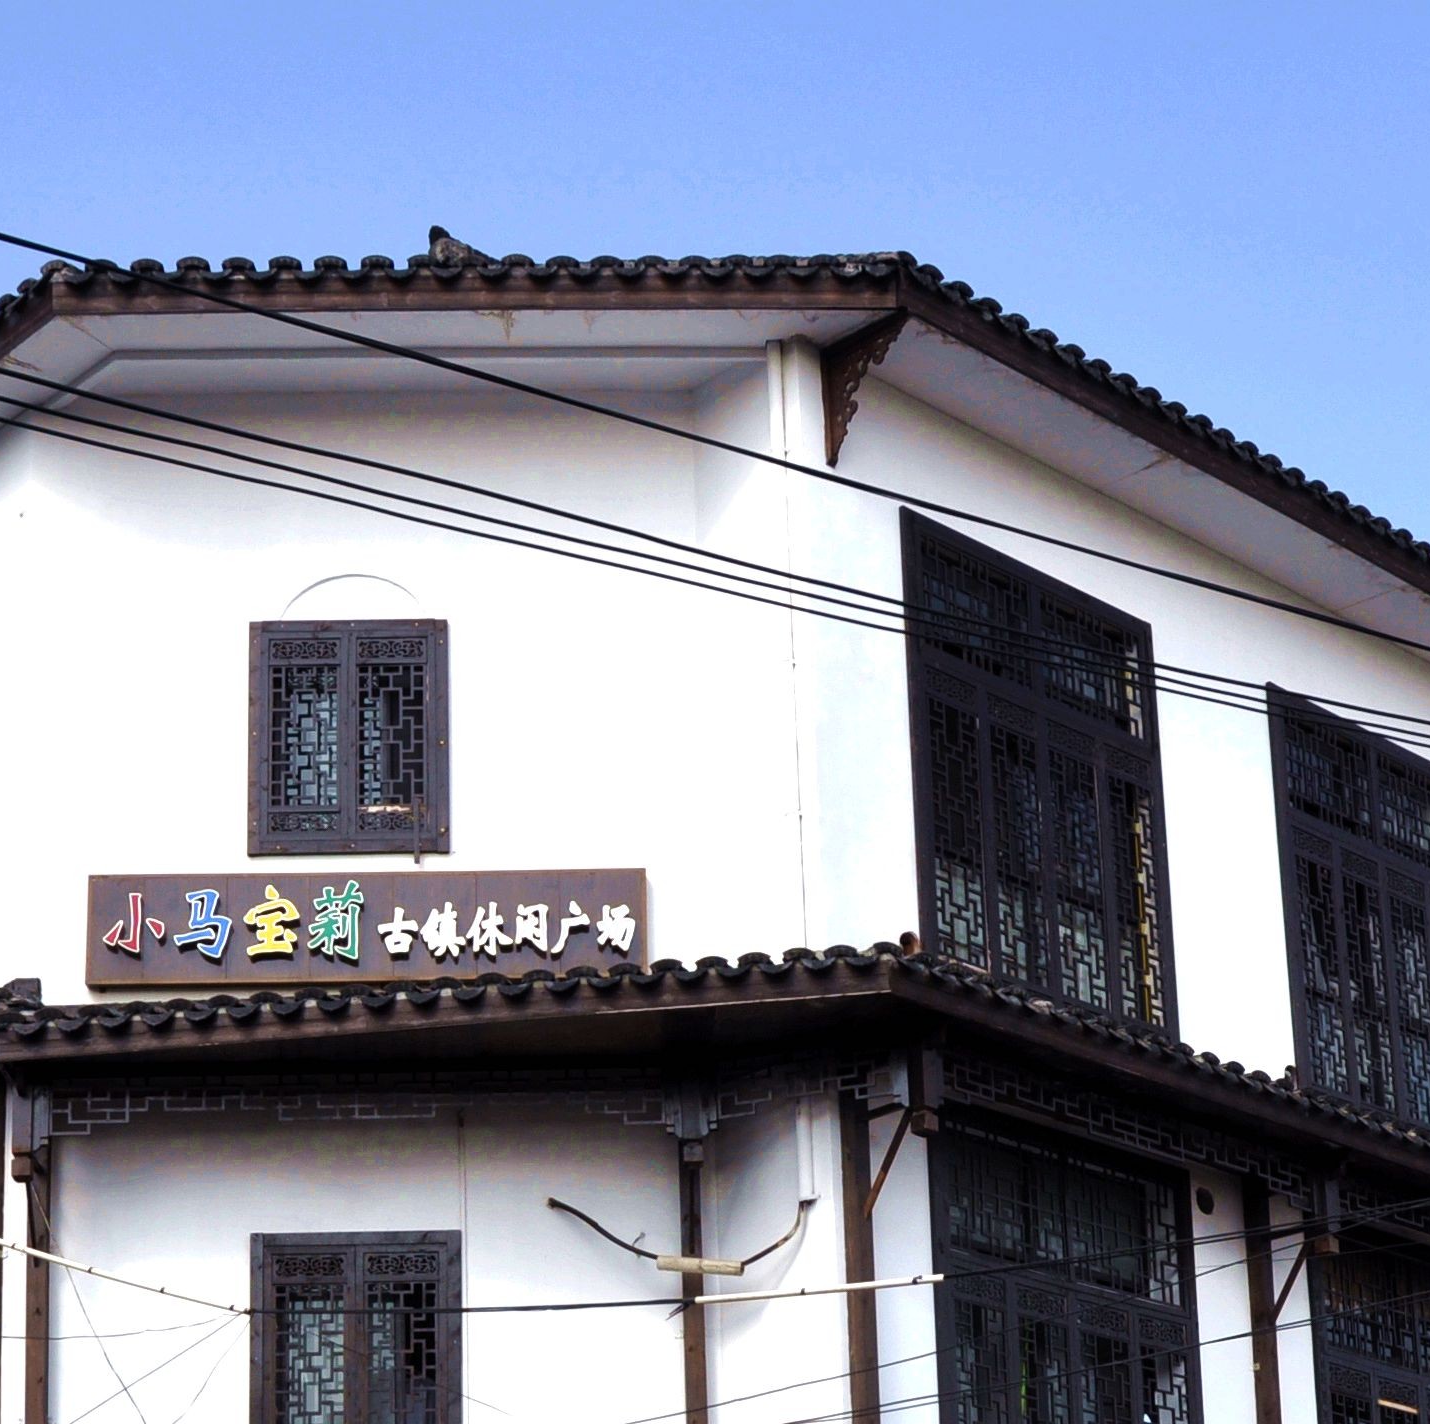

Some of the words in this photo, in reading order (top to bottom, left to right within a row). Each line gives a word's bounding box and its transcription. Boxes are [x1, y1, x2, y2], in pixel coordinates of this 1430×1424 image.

[103, 880, 364, 959] 小马宝莉
[377, 900, 637, 957] 古镇休闲广场
